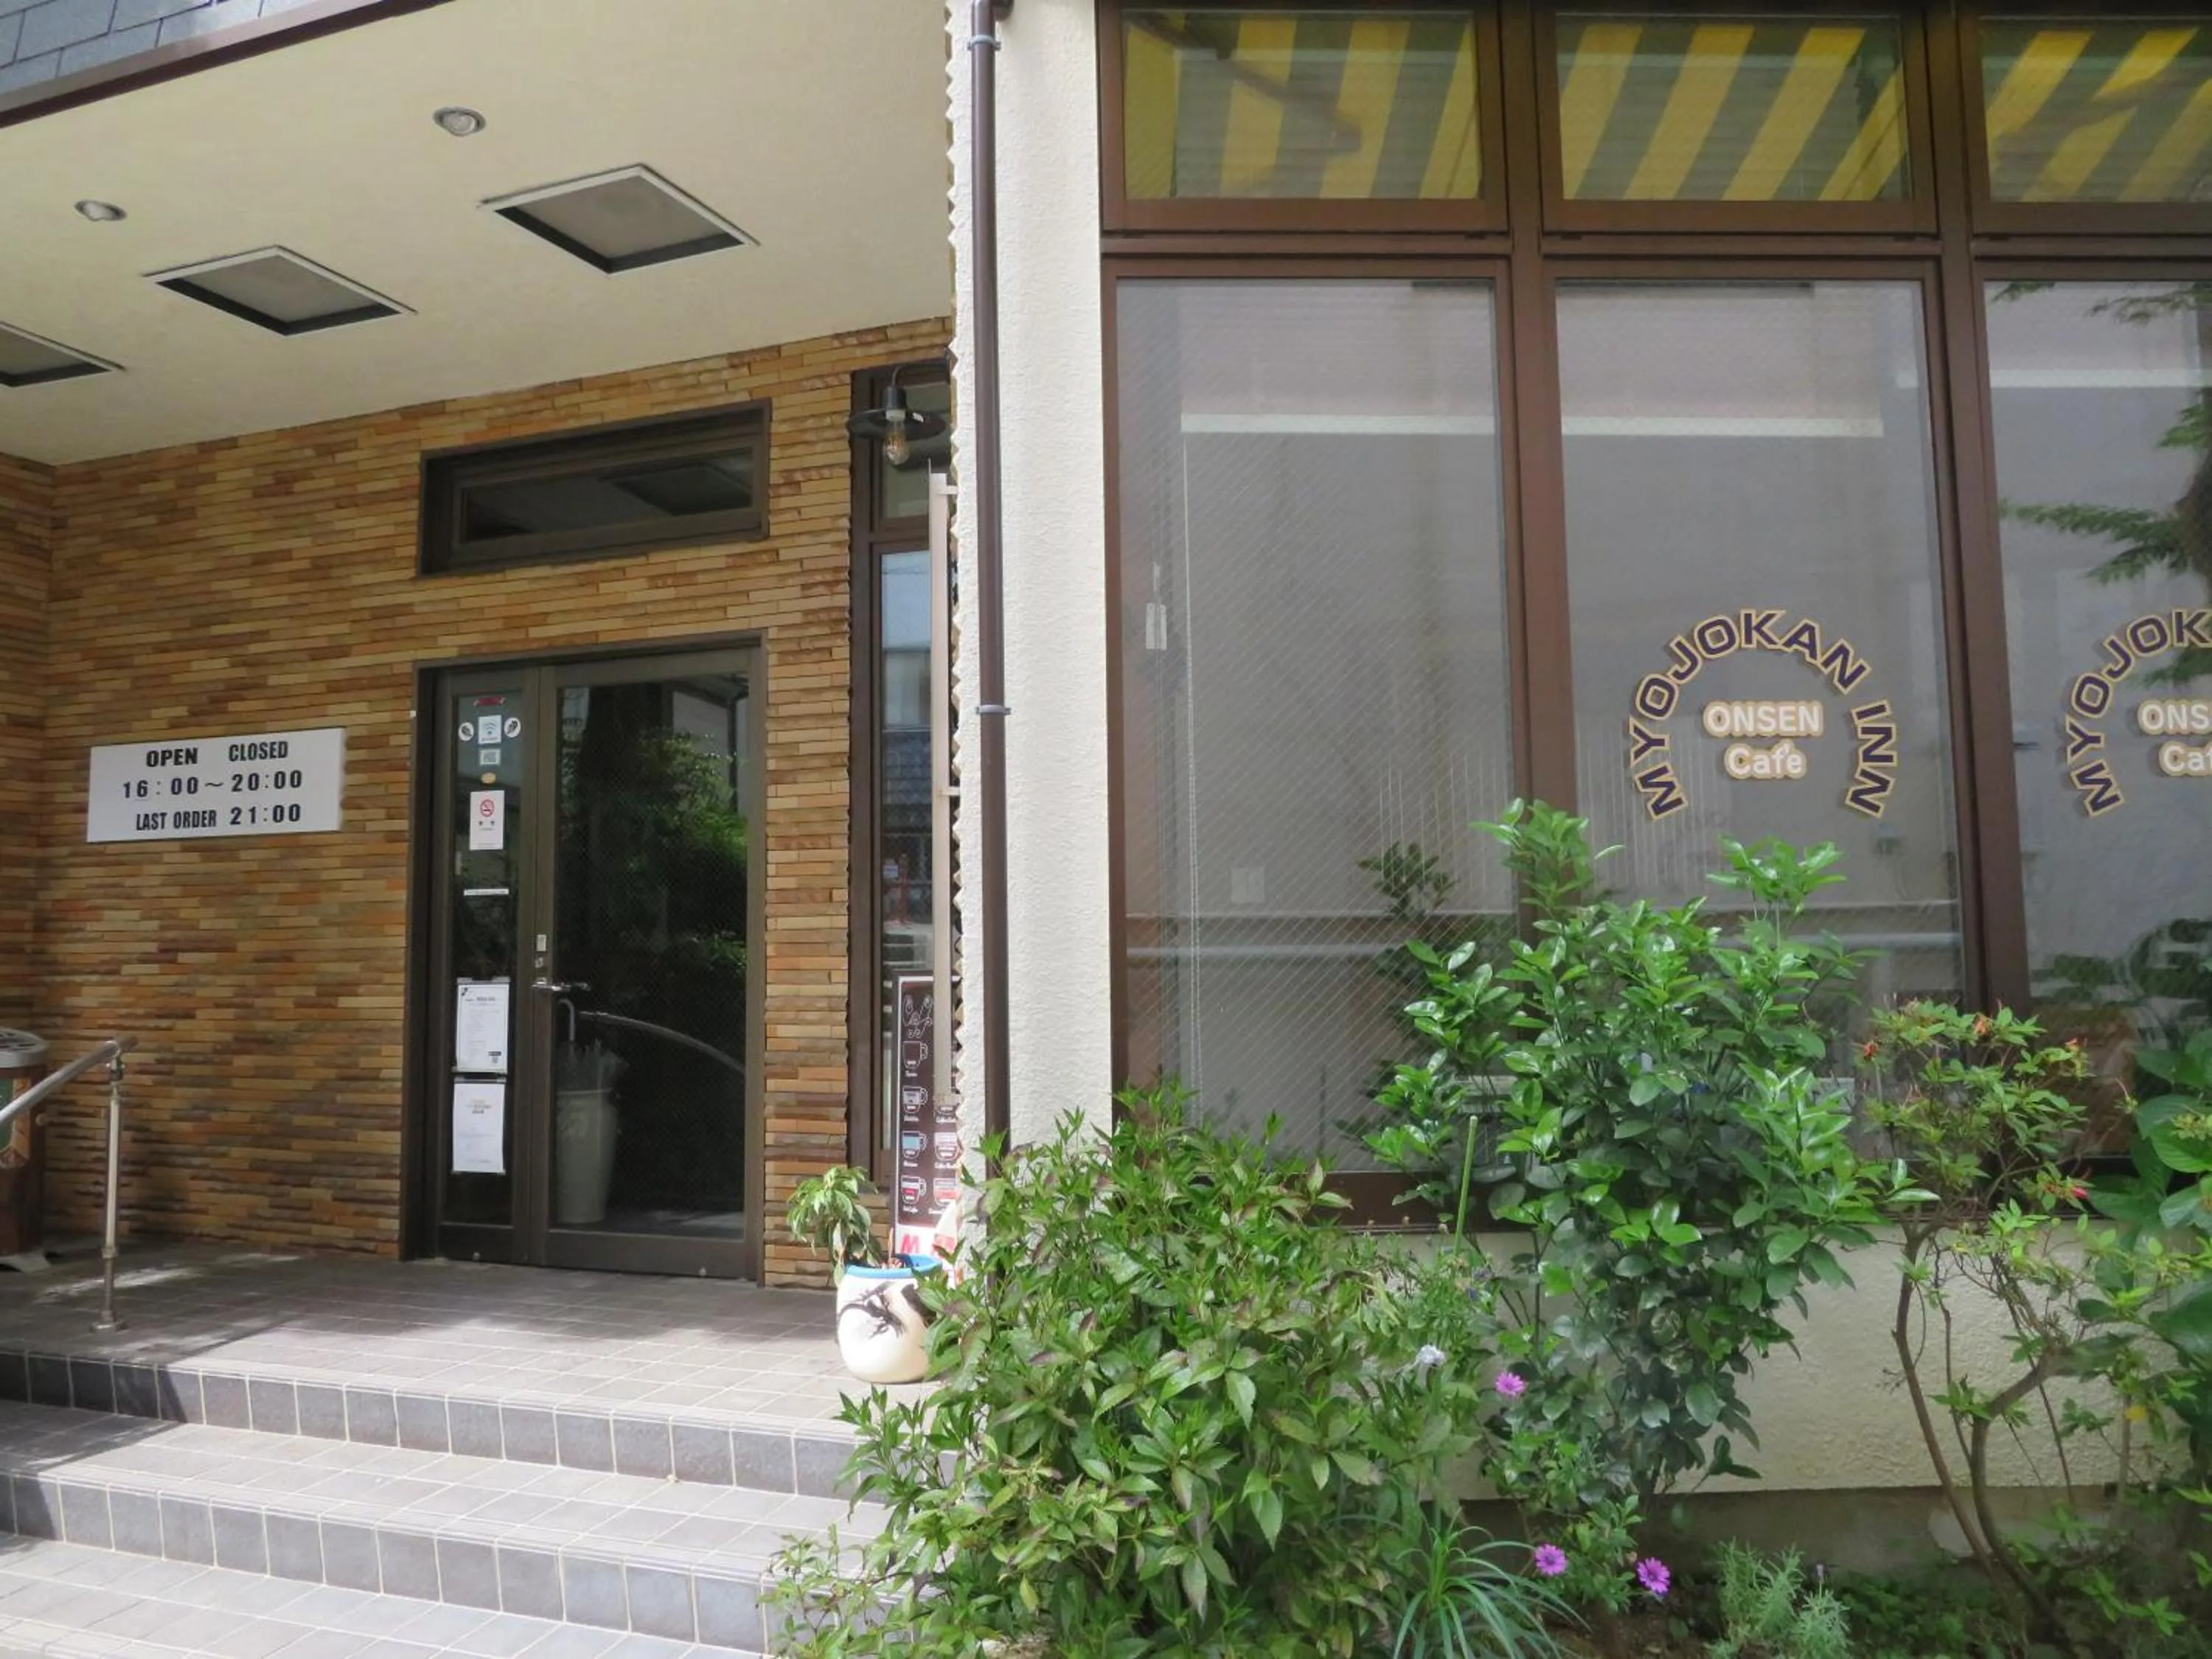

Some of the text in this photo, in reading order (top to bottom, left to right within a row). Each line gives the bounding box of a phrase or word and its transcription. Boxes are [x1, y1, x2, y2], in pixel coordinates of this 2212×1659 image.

[1629, 609, 1897, 821] MYOJOKAN INN
[1704, 702, 1822, 736] ONSEN
[146, 741, 289, 768] OPEN CLOSED
[136, 804, 302, 831] LAST ORDER 21:00
